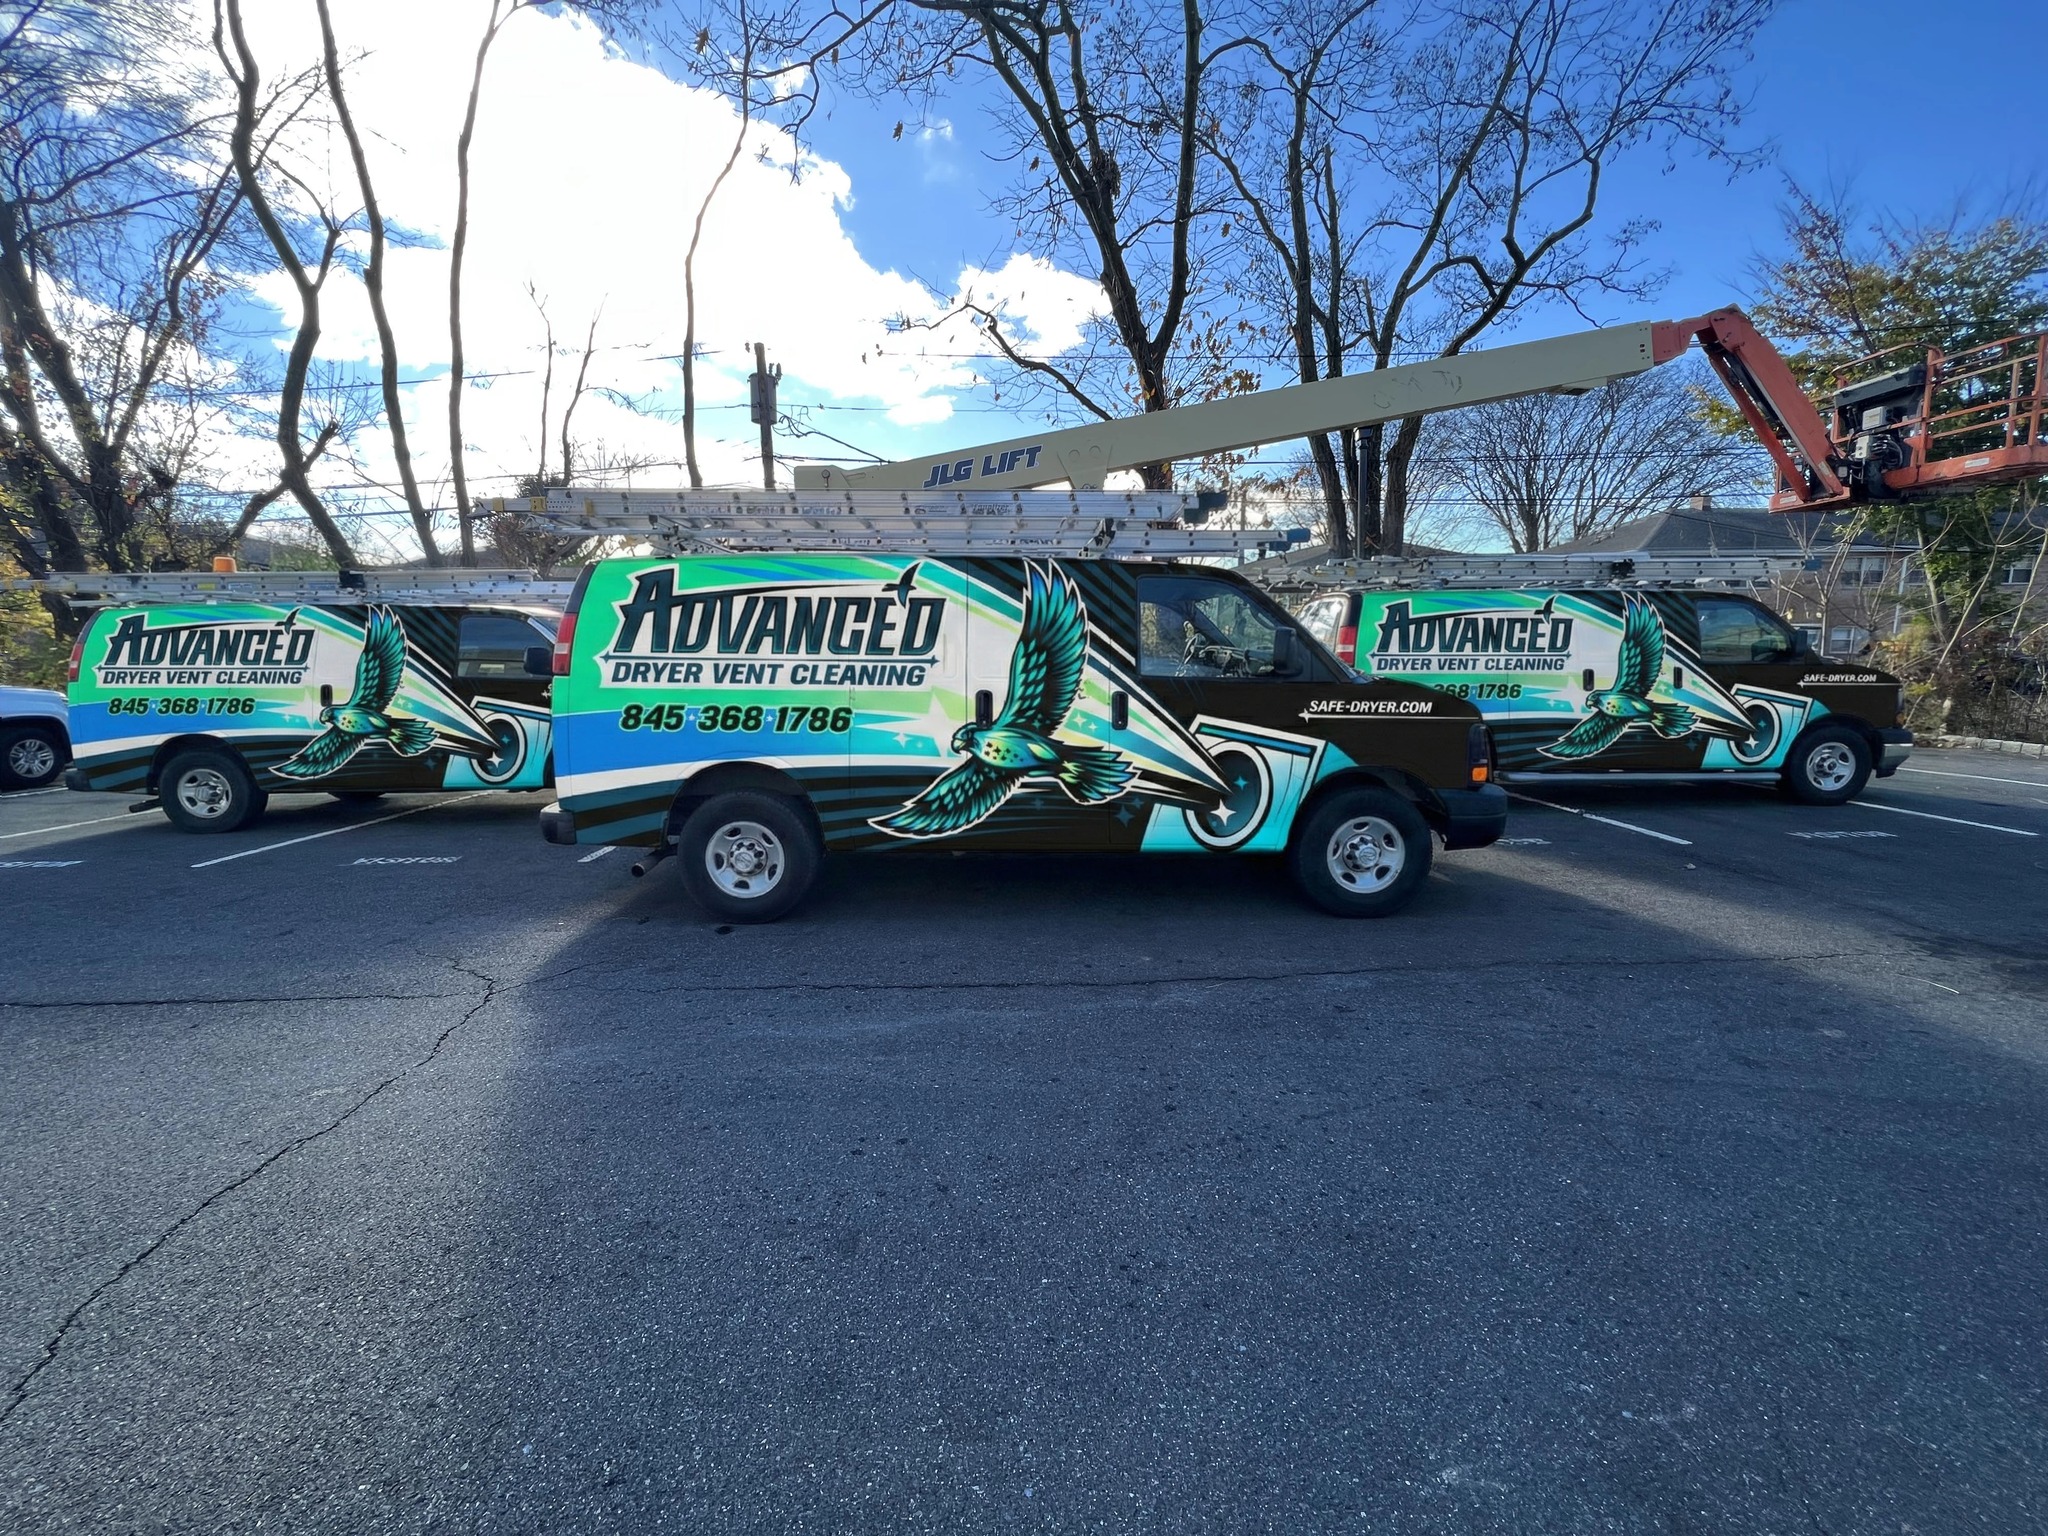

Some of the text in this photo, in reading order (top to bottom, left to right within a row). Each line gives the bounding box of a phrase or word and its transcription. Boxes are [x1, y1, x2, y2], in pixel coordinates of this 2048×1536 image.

[922, 445, 1043, 488] JLG LIFT
[613, 568, 946, 656] ADVANCED
[1377, 601, 1574, 653] ADVANCED
[104, 614, 315, 666] ADVANCED
[611, 662, 926, 686] DRYER VENT CLEANING
[1376, 658, 1565, 671] DRYER VENT CLEANING
[103, 671, 302, 685] DRYER VENT CLEANING
[1477, 683, 1522, 699] 1786
[108, 697, 255, 715] 845 368 1786
[1309, 700, 1433, 714] SAFE-DRYER.COM
[620, 704, 853, 733] 845 368 1786
